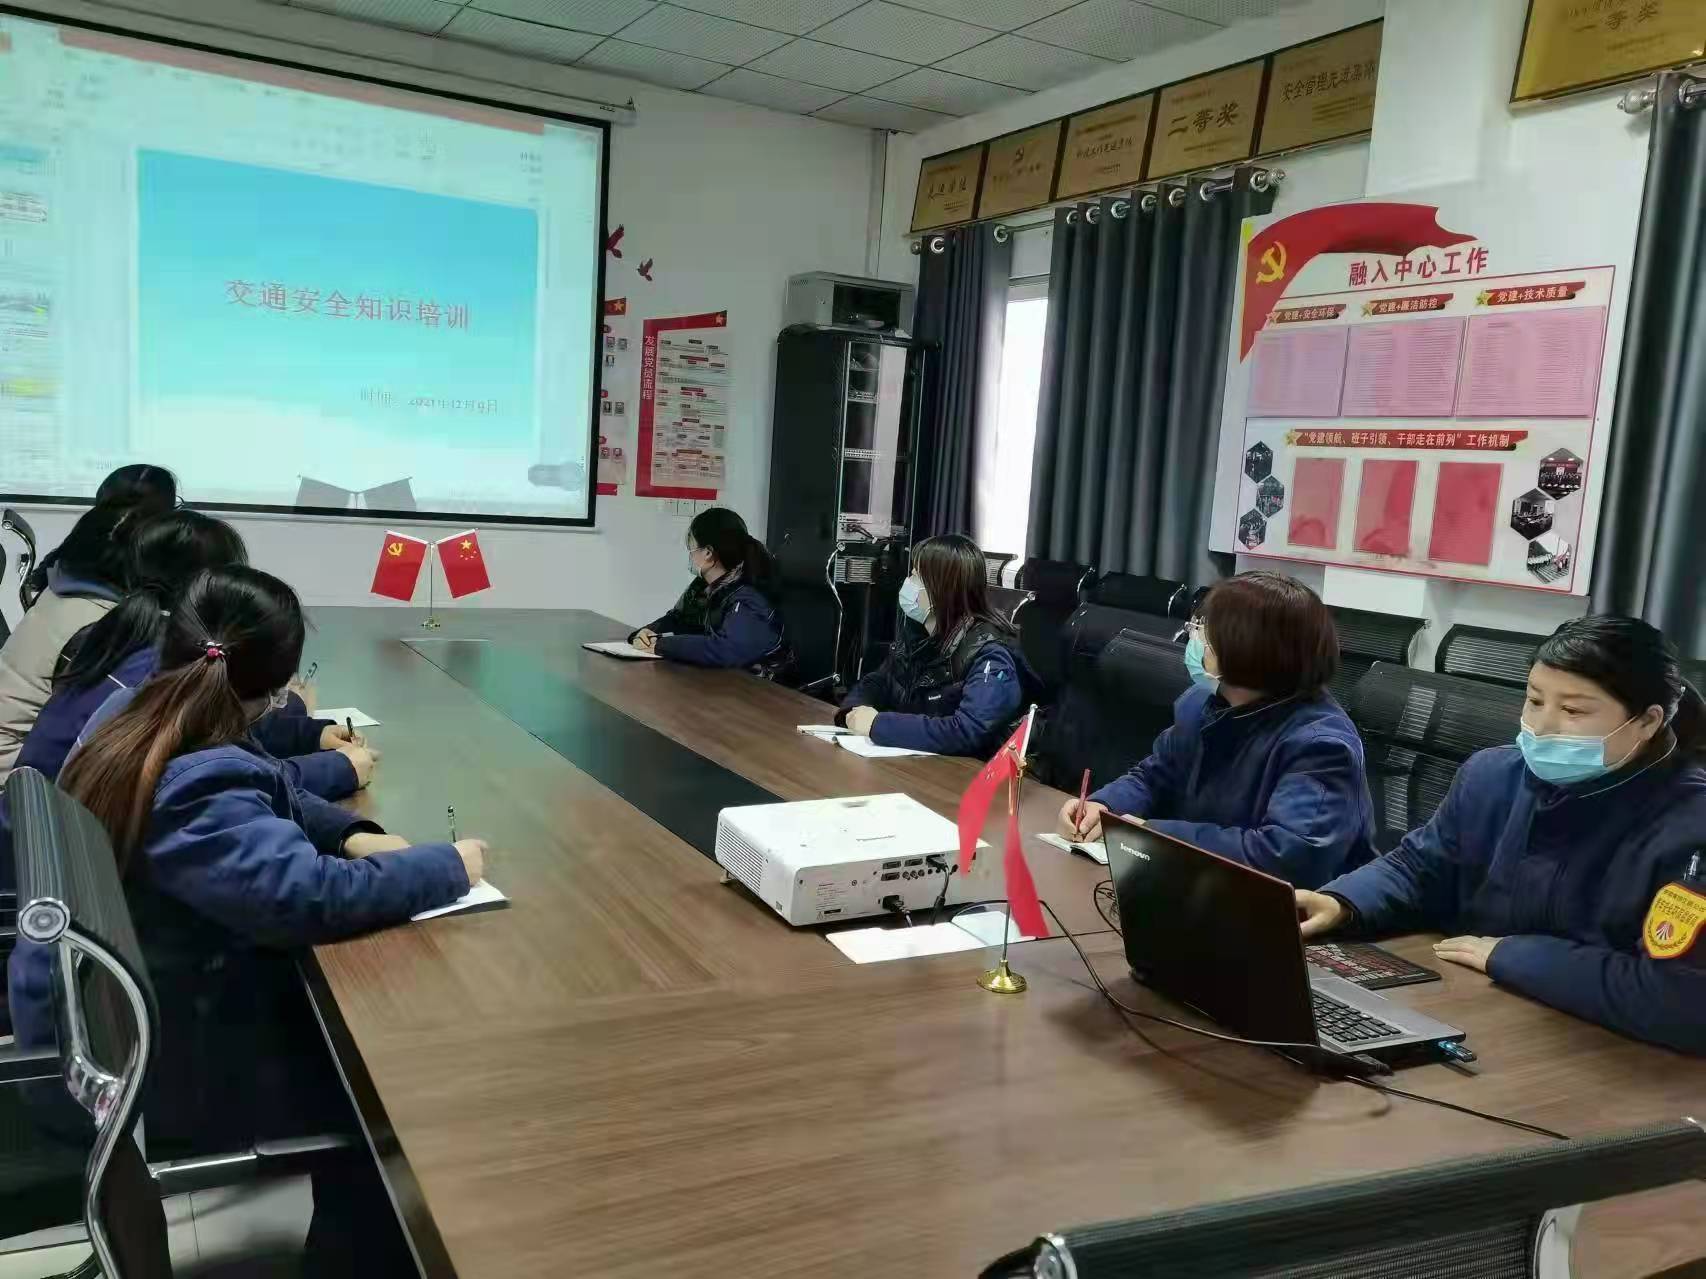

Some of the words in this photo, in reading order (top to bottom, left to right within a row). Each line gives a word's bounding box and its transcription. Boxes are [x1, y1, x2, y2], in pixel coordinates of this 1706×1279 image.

[1168, 102, 1239, 136] 二等奖
[1348, 247, 1489, 287] 融入中心工作
[225, 279, 470, 331] 交通安全知识培训
[1496, 286, 1569, 302] 党建+技术质量
[1284, 307, 1335, 321] 党建+安全环保
